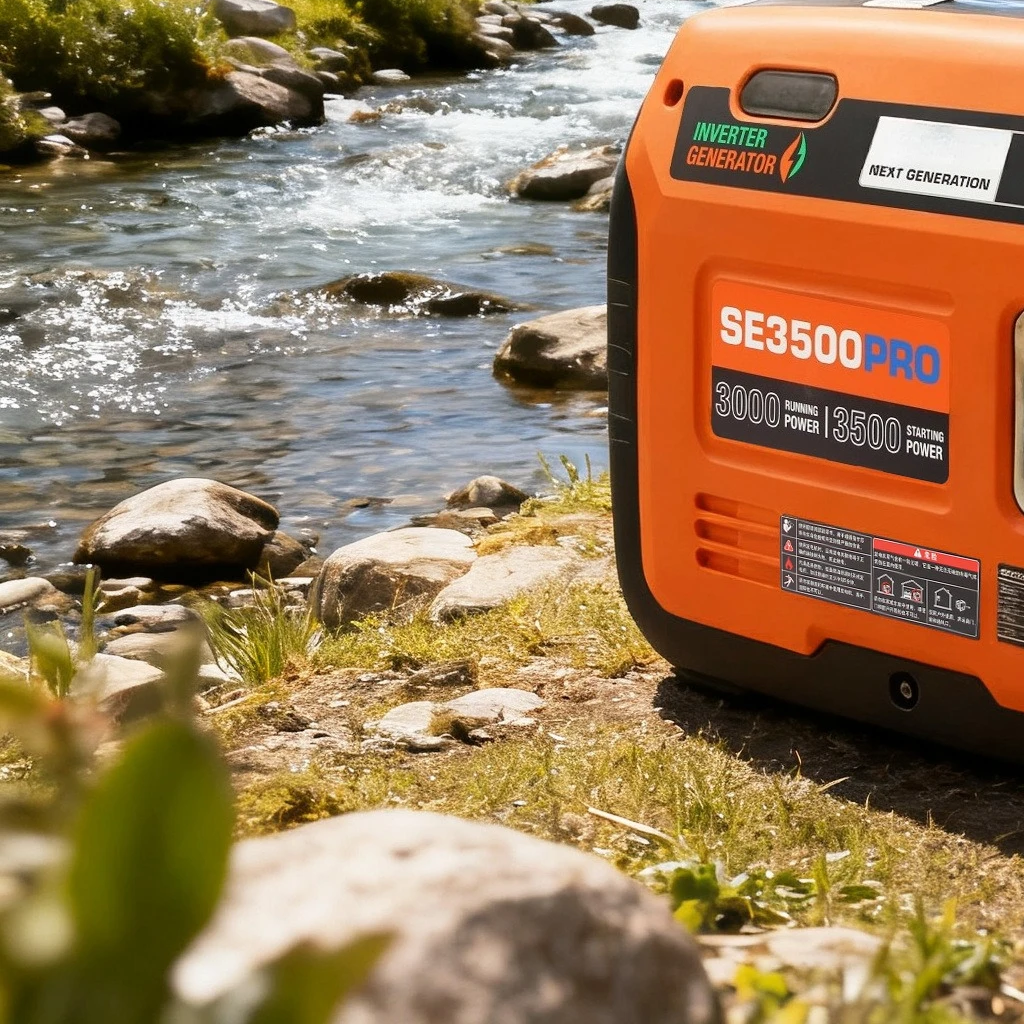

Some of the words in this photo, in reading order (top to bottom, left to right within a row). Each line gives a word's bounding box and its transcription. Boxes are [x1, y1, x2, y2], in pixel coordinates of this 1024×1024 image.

[693, 122, 768, 148] INVERTER
[686, 145, 777, 175] GENERATOR
[868, 164, 904, 179] NEXT
[905, 169, 991, 190] GENERATION
[719, 305, 941, 385] SE3500PRO
[715, 381, 781, 428] 3000
[784, 399, 819, 417] RUNNING
[784, 413, 820, 434] POWER
[832, 406, 901, 454] 3500
[906, 424, 945, 443] STARTING
[906, 439, 943, 461] POWER
